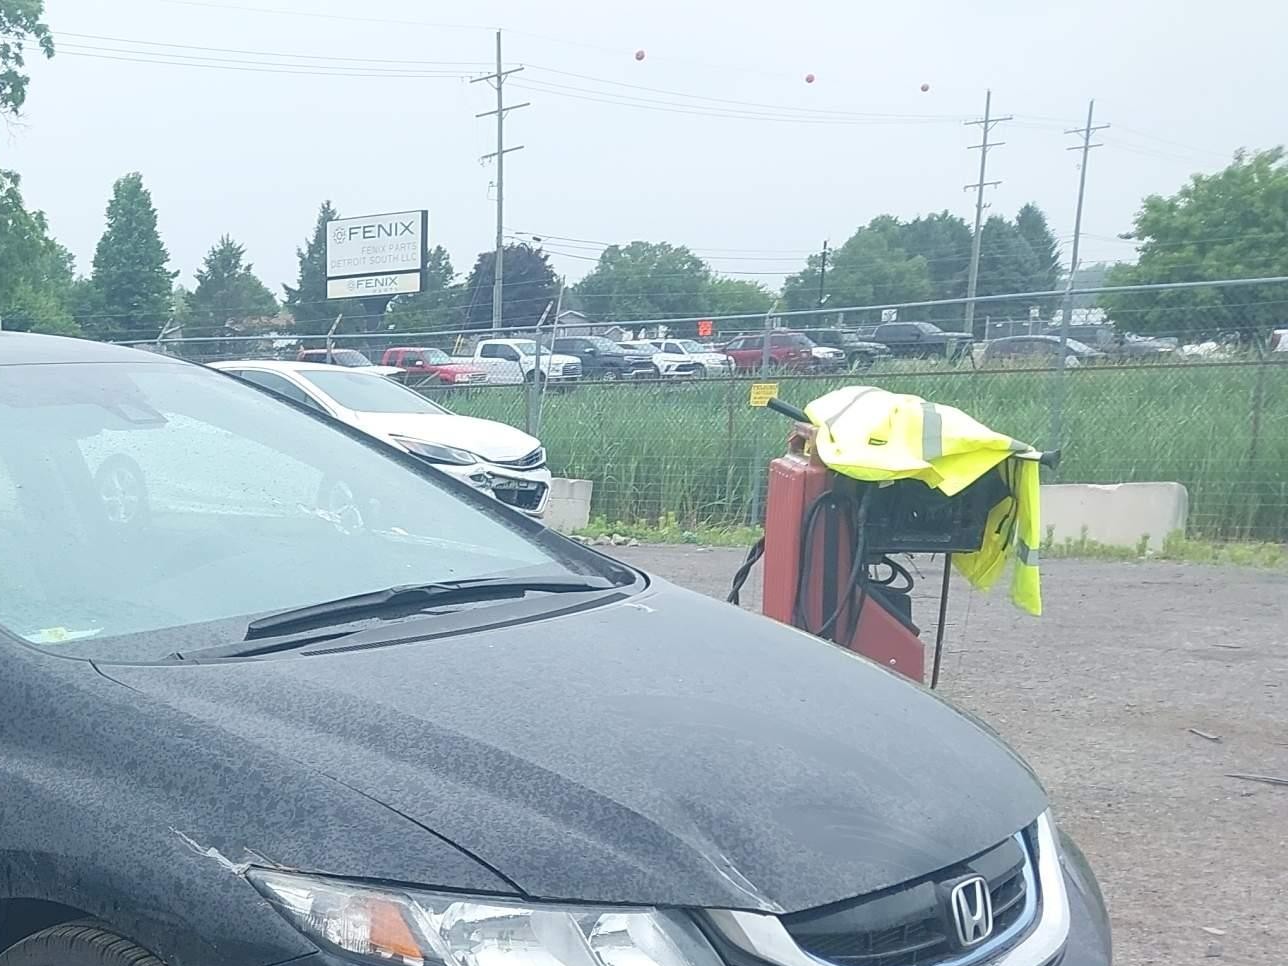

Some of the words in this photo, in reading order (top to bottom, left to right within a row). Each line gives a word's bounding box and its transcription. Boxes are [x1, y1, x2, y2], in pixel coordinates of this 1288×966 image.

[348, 220, 415, 241] FENIX
[361, 246, 386, 256] FENIX
[389, 241, 417, 252] PARTS
[330, 256, 367, 269] DETROIT
[369, 254, 400, 265] SOUTH
[401, 251, 417, 263] LLC
[356, 276, 399, 289] FENIX
